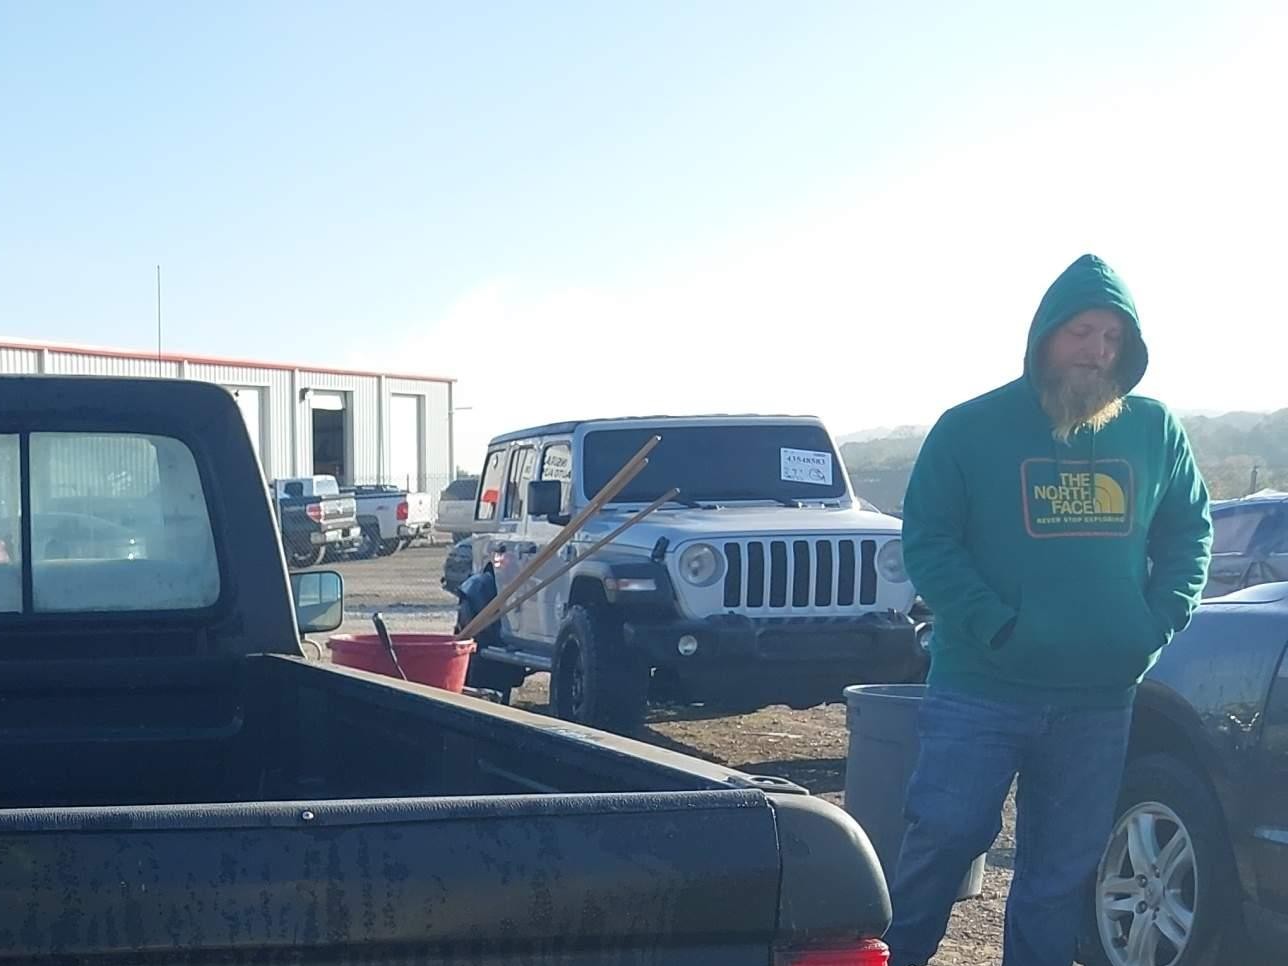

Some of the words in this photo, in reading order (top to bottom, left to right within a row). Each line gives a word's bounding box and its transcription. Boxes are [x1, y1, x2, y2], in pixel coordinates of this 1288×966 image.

[1059, 472, 1091, 487] THE
[1034, 485, 1092, 500] NORTH
[1052, 499, 1093, 514] FACE
